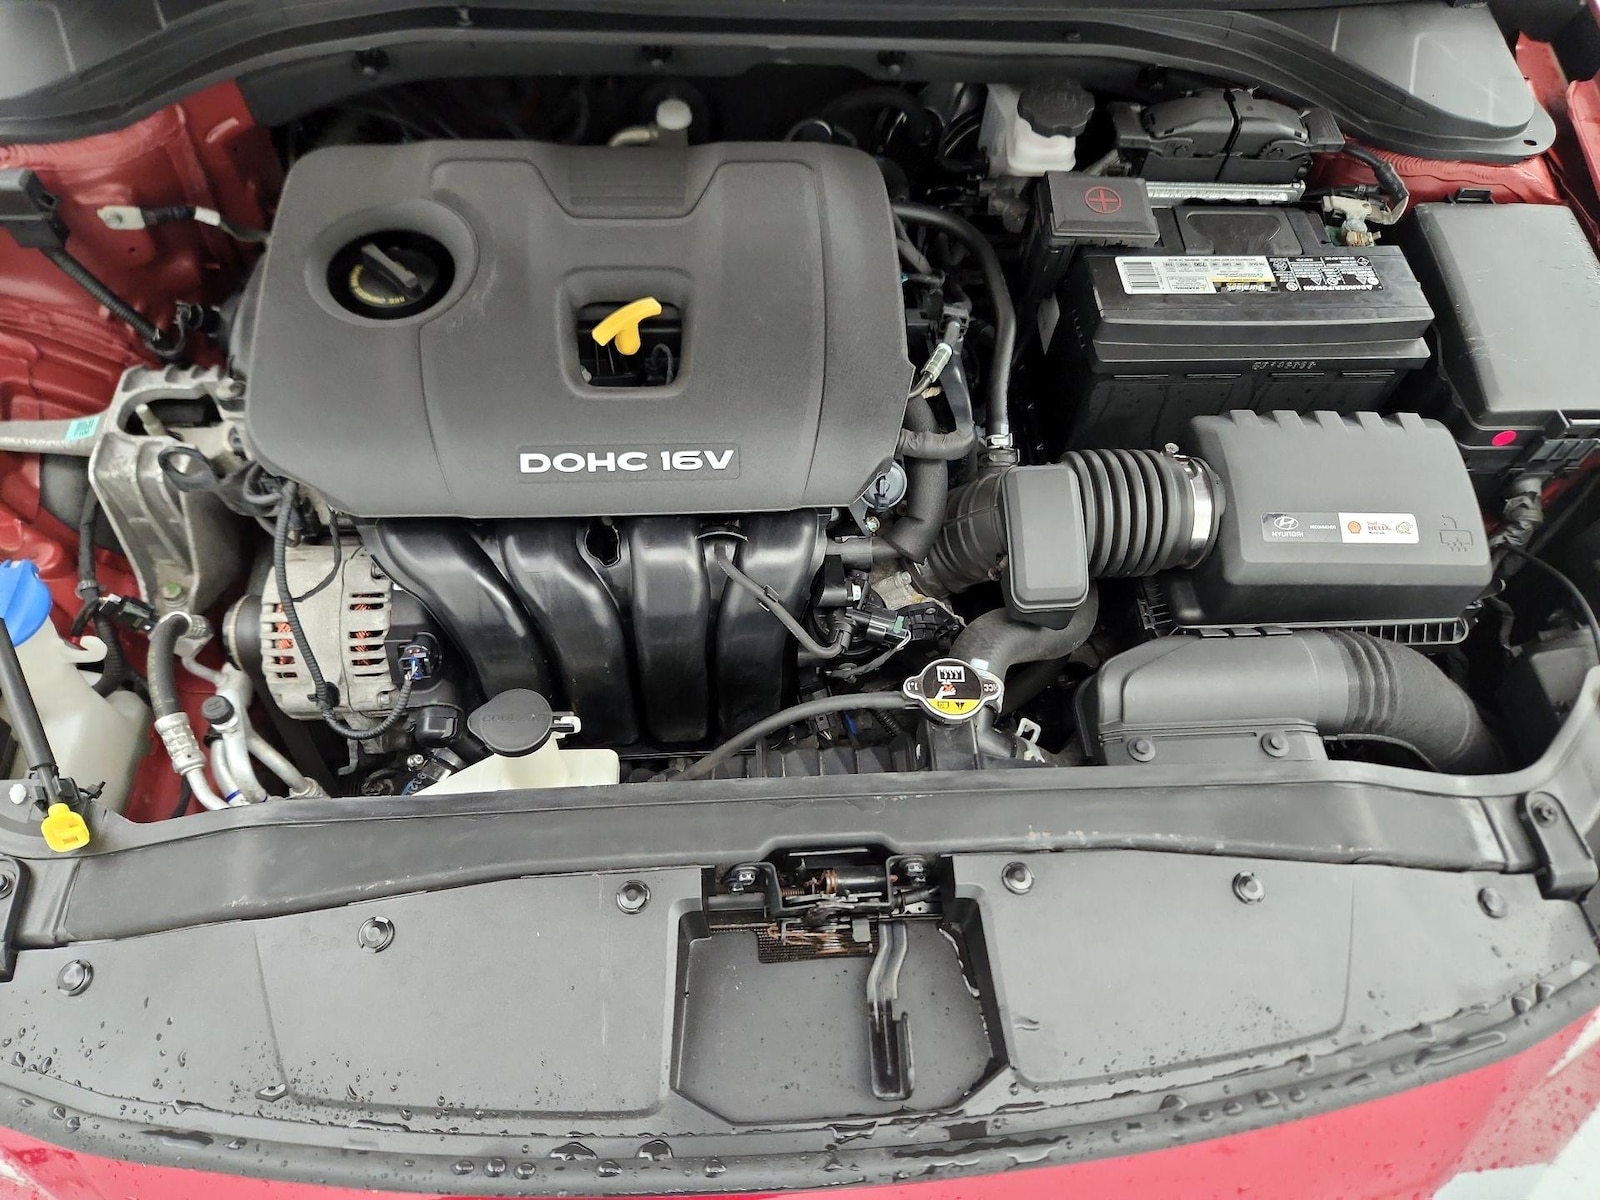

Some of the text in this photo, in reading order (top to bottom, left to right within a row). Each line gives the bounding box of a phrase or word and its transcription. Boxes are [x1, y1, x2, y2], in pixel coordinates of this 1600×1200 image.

[519, 449, 735, 473] DOHC 16V
[1271, 530, 1304, 538] HYUNDAI
